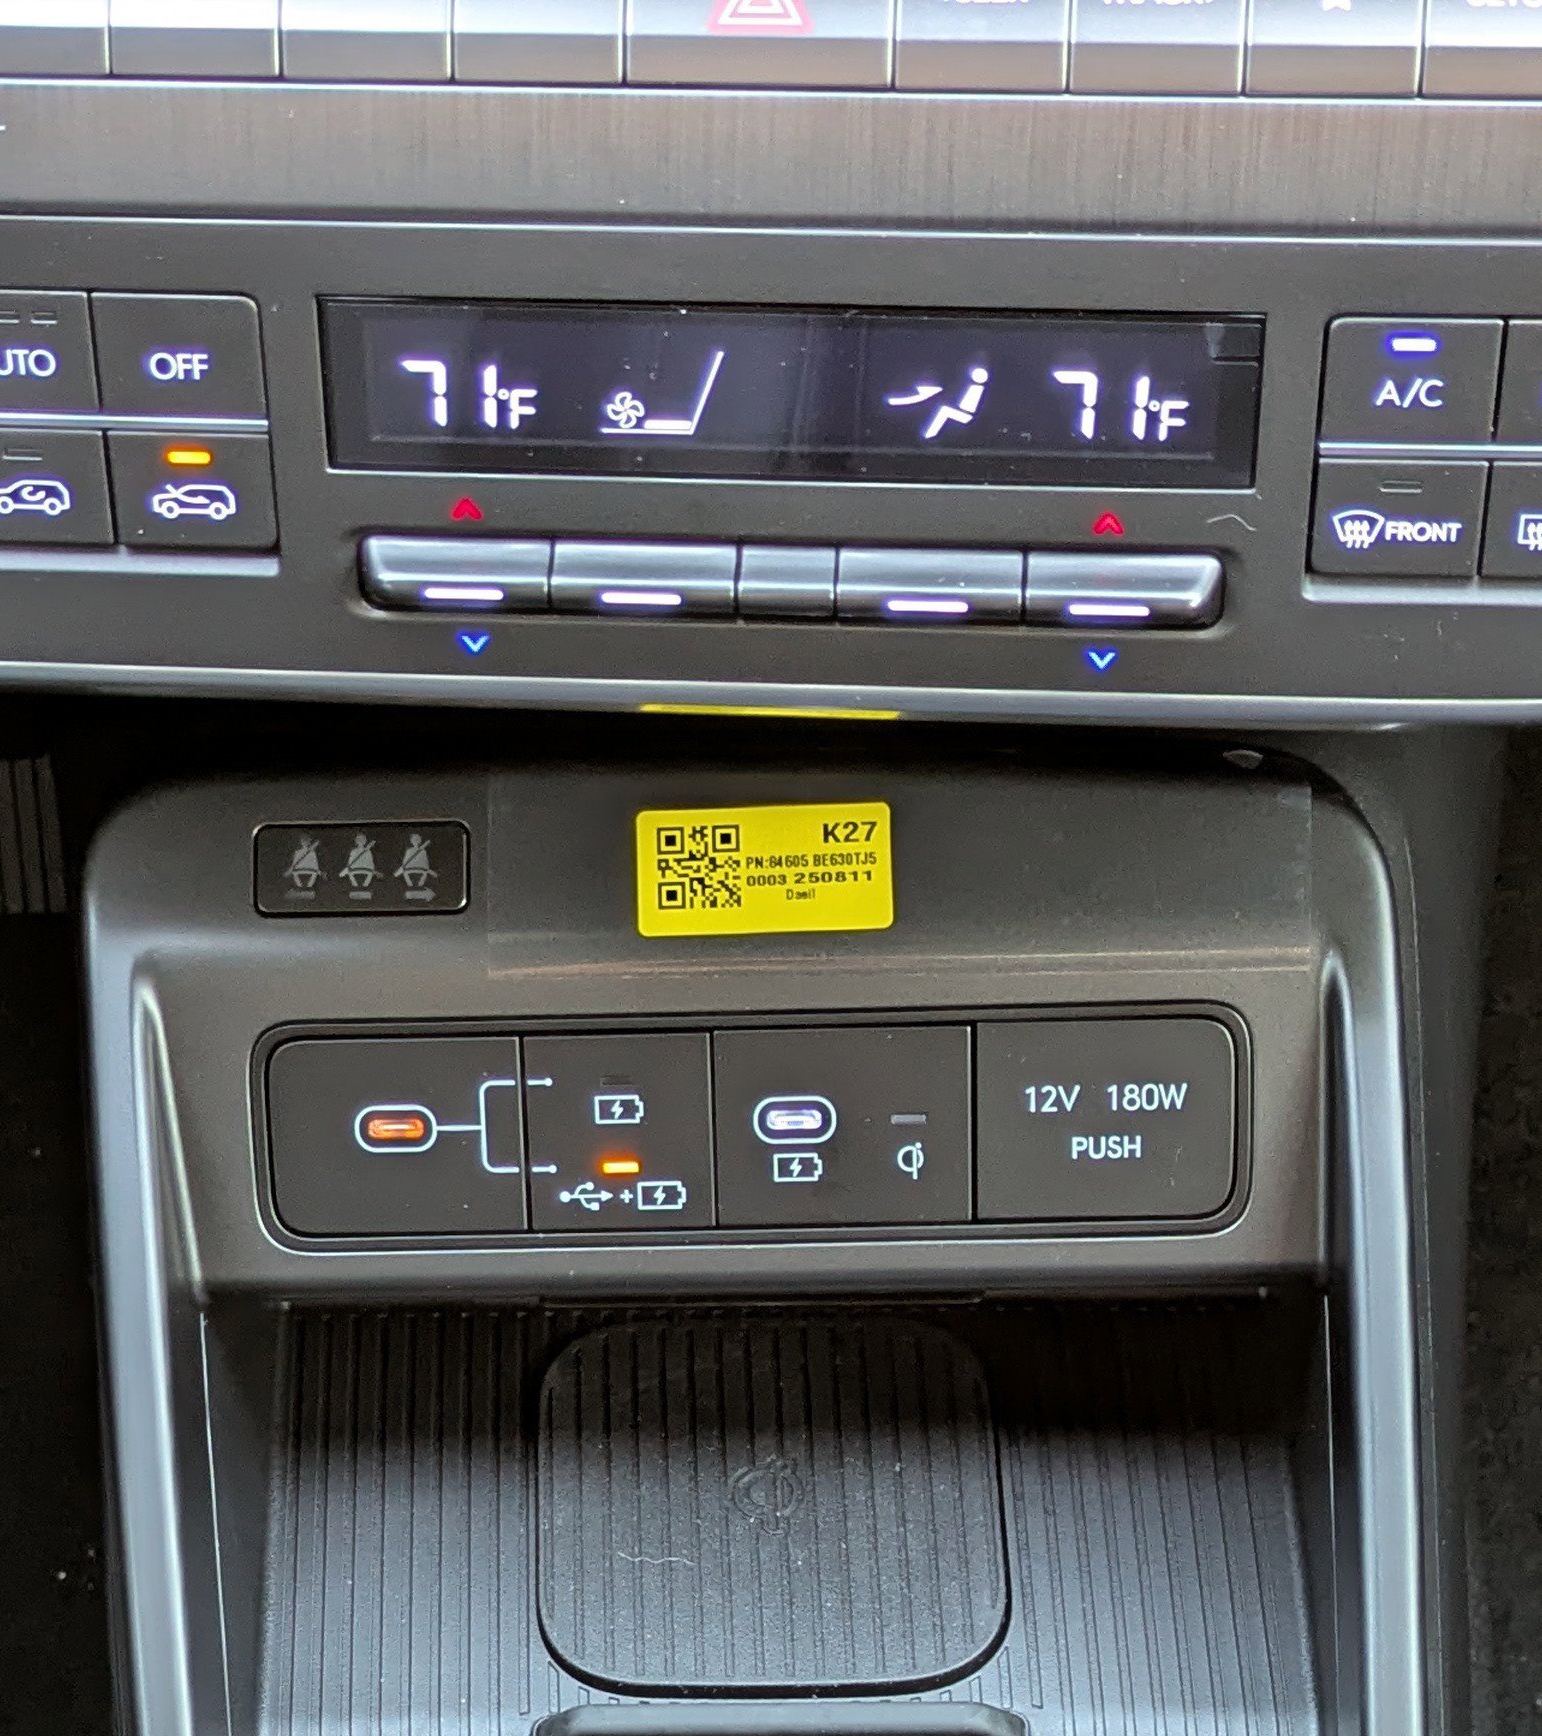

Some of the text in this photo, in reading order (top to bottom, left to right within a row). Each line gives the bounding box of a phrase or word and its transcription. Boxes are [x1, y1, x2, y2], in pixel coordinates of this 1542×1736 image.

[150, 352, 209, 380] OFF
[1376, 378, 1444, 408] A/C
[1385, 522, 1461, 542] FRONT
[822, 821, 877, 843] K27
[746, 870, 872, 886] 0003 250811
[1024, 1083, 1188, 1113] 12V 180W
[1071, 1135, 1142, 1160] PUSH
